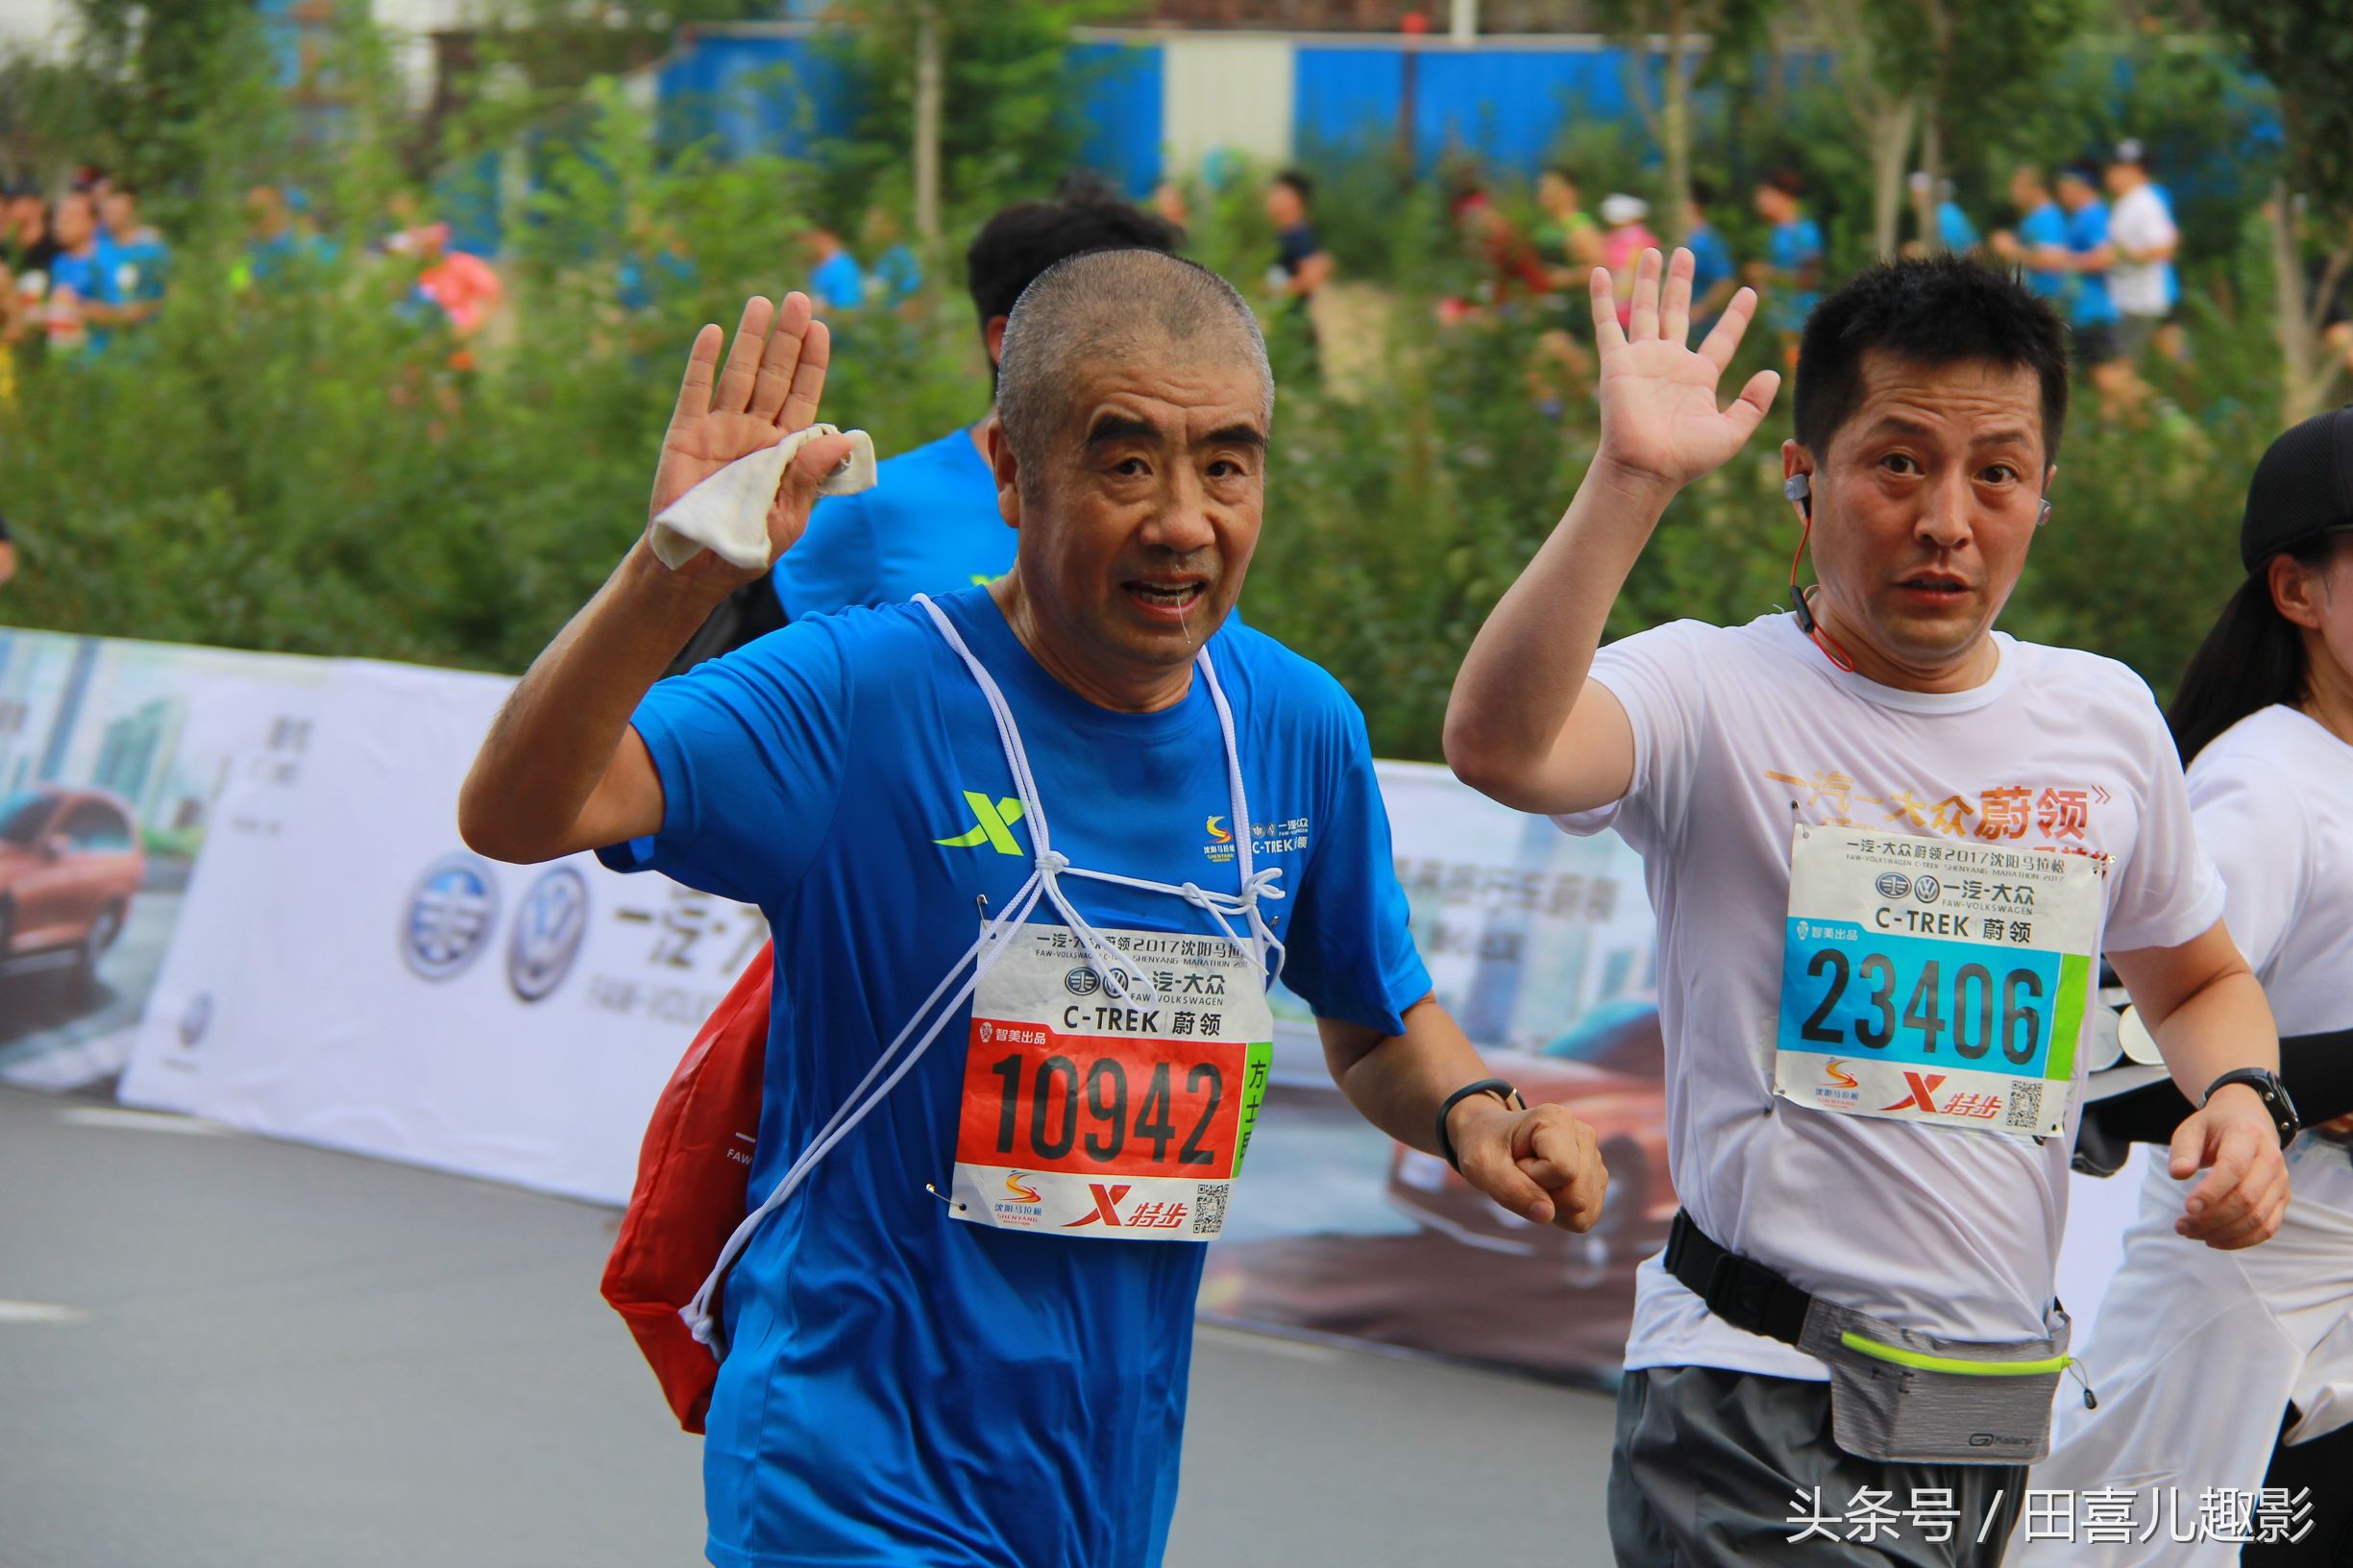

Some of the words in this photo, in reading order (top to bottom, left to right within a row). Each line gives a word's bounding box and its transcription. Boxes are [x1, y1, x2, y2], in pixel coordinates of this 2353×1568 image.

[1992, 869, 2039, 880] MARATHON
[1943, 880, 2035, 905] 一汽-大众
[1942, 899, 2033, 916] FAW-VOLKSWAGEN
[1875, 906, 1970, 938] C-TREK
[1982, 918, 2032, 943] 蔚领
[1036, 949, 1101, 961] FAW-VOLKSWAG
[1133, 954, 1179, 965] SHENYANG
[1183, 958, 1230, 968] MARATHON
[1801, 947, 2044, 1066] 23406
[1064, 1005, 1160, 1034] C-TREK
[1172, 1011, 1222, 1037] 蔚领
[995, 1028, 1046, 1045] 智美出品
[992, 1053, 1224, 1165] 10942
